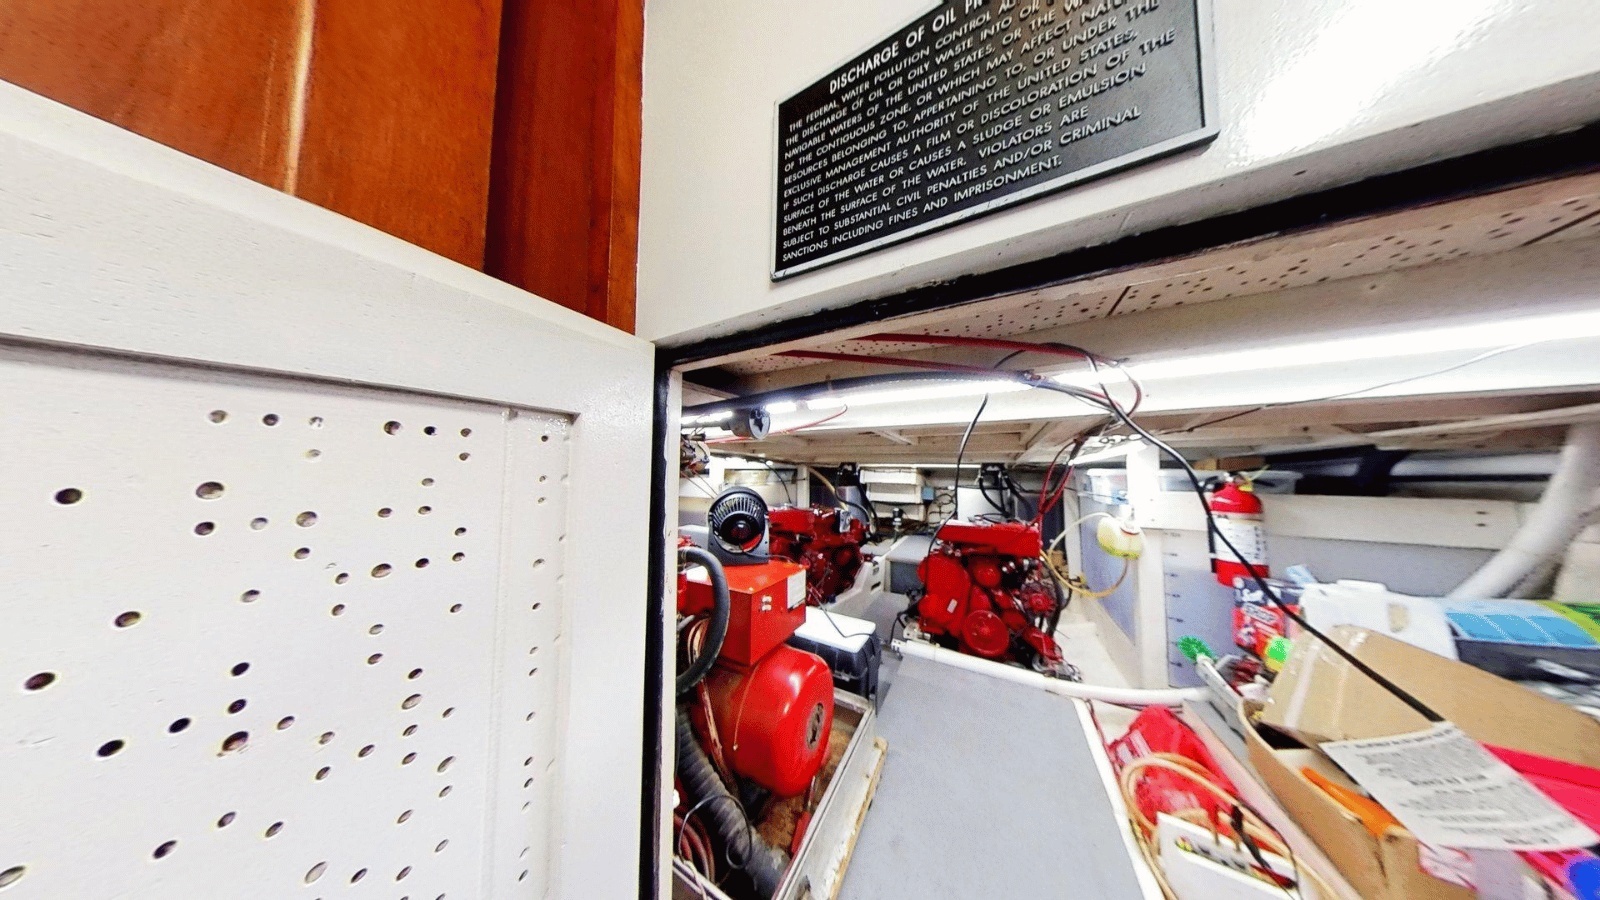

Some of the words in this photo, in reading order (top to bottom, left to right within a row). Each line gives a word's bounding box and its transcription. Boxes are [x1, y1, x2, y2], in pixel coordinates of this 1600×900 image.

[783, 202, 789, 211] IF
[793, 192, 814, 207] SUCH
[817, 168, 866, 196] DISCHARGE
[870, 149, 908, 172] CAUSES
[913, 144, 921, 154] A
[926, 130, 951, 148] FILM
[957, 119, 975, 135] OR
[980, 63, 1097, 125] DISCOLORATION
[1106, 48, 1130, 69] OF
[1139, 28, 1176, 54] THE
[784, 132, 826, 160] NAVIGABLE
[829, 113, 862, 137] WATERS
[867, 104, 879, 117] OF
[885, 91, 903, 107] THE
[907, 68, 948, 95] UNITED
[1002, 27, 1022, 45] OR
[1030, 9, 1056, 31] THE
[784, 161, 795, 172] OF
[799, 152, 813, 165] THE
[816, 121, 875, 156] CONTIGUOUS
[916, 91, 932, 106] OR
[937, 66, 980, 95] WHICH
[986, 49, 1014, 71] MAY
[1021, 19, 1072, 54] AFFECT
[784, 159, 828, 185] RESOURCES
[832, 129, 887, 162] BELONGING
[913, 75, 997, 123] APPERTAINING
[1033, 46, 1055, 65] OR
[1062, 17, 1117, 51] UNDER
[785, 135, 799, 147] THE
[802, 107, 847, 138] DISCHARGE
[851, 98, 863, 111] OF
[868, 88, 883, 102] OIL
[888, 76, 903, 91] OR
[907, 61, 930, 80] OILY
[935, 36, 973, 65] WASTE
[981, 16, 1013, 41] INTO
[789, 119, 803, 132] THE
[806, 100, 837, 123] FEDERAL
[841, 81, 870, 103] WATER
[874, 46, 930, 85] POLLUTION
[935, 11, 991, 49] CONTROL
[830, 41, 899, 94] DISCHARGE
[905, 25, 925, 48] OF
[932, 7, 956, 32] OIL
[783, 204, 814, 223] SURFACE
[818, 197, 830, 209] OF
[834, 189, 850, 203] THE
[854, 175, 884, 193] WATER
[889, 166, 904, 179] OR
[908, 145, 952, 171] CAUSES
[957, 140, 966, 151] A
[972, 115, 1022, 145] SLUDGE
[1029, 102, 1051, 120] OR
[1059, 62, 1146, 108] EMULSION
[783, 217, 816, 236] BENEATH
[821, 208, 836, 221] THE
[840, 192, 878, 214] SURFACE
[882, 184, 896, 197] OF
[902, 174, 921, 189] THE
[979, 121, 1052, 158] VIOLATORS
[1060, 105, 1089, 127] ARE
[783, 230, 814, 249] SUBJECT
[819, 225, 830, 236] TO
[834, 202, 891, 230] SUBSTANTIAL
[896, 190, 921, 207] CIVIL
[927, 164, 988, 195] PENALTIES
[993, 140, 1052, 170] AND/OR
[1060, 105, 1141, 145] CRIMINAL
[784, 174, 822, 198] EXCLUSIVE
[825, 142, 891, 179] MANAGEMENT
[896, 111, 956, 147] AUTHORITY
[962, 100, 979, 115] OF
[986, 85, 1011, 104] THE
[1017, 57, 1071, 90] UNITED
[782, 239, 828, 262] SANCTIONS
[832, 220, 883, 244] INCLUDING
[888, 207, 918, 225] FINES
[923, 196, 948, 213] AND
[954, 154, 1062, 202] IMPRISONMENT.
